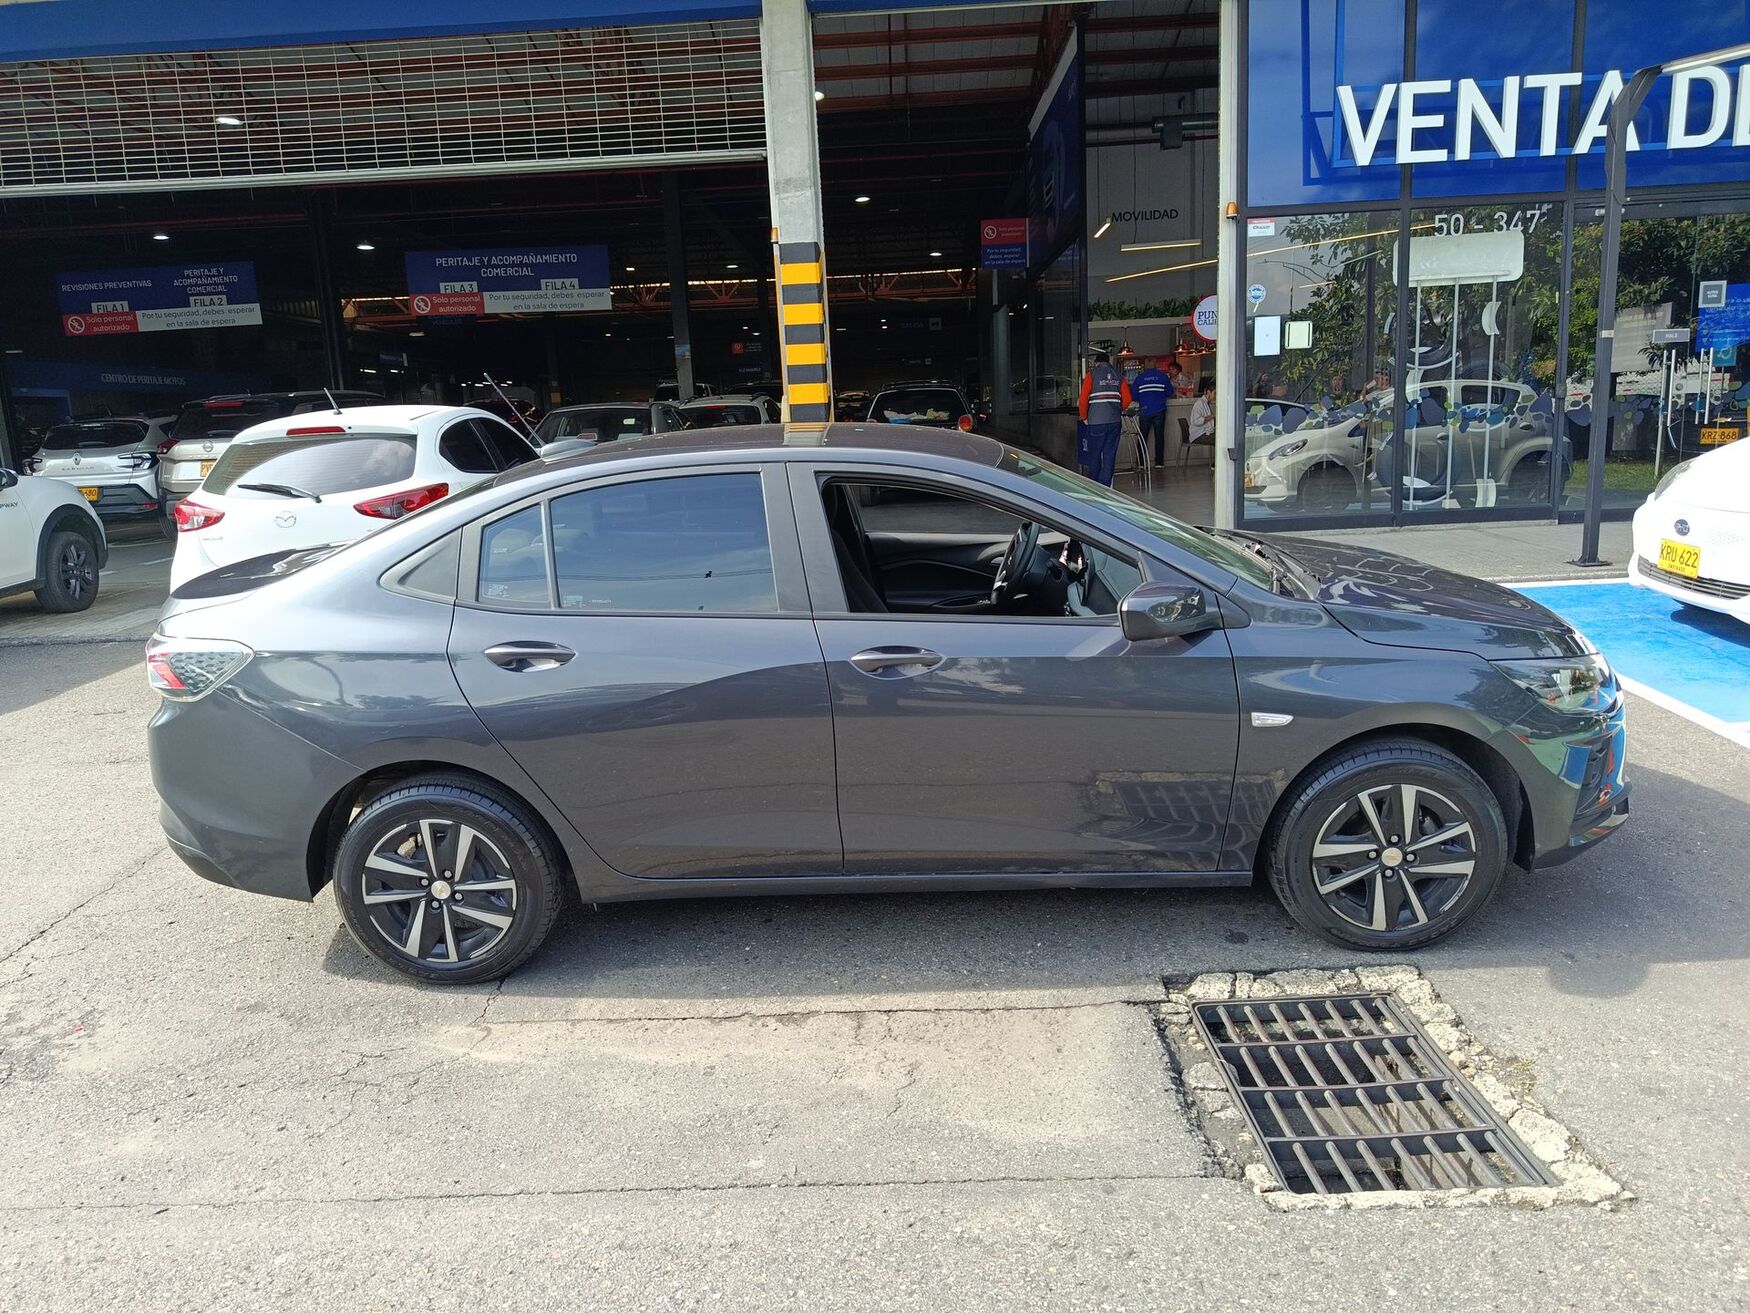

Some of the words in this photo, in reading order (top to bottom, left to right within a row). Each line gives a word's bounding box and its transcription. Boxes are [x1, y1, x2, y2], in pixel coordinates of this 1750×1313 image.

[1336, 69, 1640, 167] VENTA
[1111, 208, 1179, 222] MOVILIDAD
[1434, 213, 1464, 237] 50
[1493, 210, 1541, 234] 347
[435, 257, 481, 267] PERITAJE
[482, 256, 489, 265] Y
[491, 252, 578, 265] ACOMPAÑAMIENTO
[184, 268, 218, 277] PERITAJE
[481, 267, 535, 277] COMERCIAL
[173, 275, 238, 286] ACOMPAÑAMIENTO
[545, 281, 567, 290] FILA
[569, 280, 575, 290] 4
[62, 282, 103, 292] REVISIONES
[104, 280, 152, 289] PREVENTIVAS
[187, 285, 227, 294] COMERCIAL
[444, 284, 465, 293] FILA
[467, 283, 474, 293] 3
[432, 296, 449, 304] Solo
[450, 295, 480, 304] personal
[488, 293, 503, 301] Por
[503, 293, 511, 301] tu
[551, 291, 574, 299] debes
[577, 291, 605, 300] esperar
[193, 298, 215, 307] FILA
[217, 297, 224, 306] 2
[524, 302, 531, 310] la
[548, 301, 558, 309] de
[558, 302, 584, 311] espera
[96, 303, 118, 312] FILA
[120, 303, 125, 312] 1
[202, 308, 224, 316] debes
[227, 307, 255, 316] esperar
[439, 305, 476, 313] autorizado
[86, 315, 102, 323] Solo
[103, 314, 134, 323] personal
[200, 318, 210, 326] de
[211, 318, 236, 327] espera
[93, 324, 130, 332] autorizado
[101, 373, 128, 384] CENTRO
[1679, 549, 1698, 569] 622
